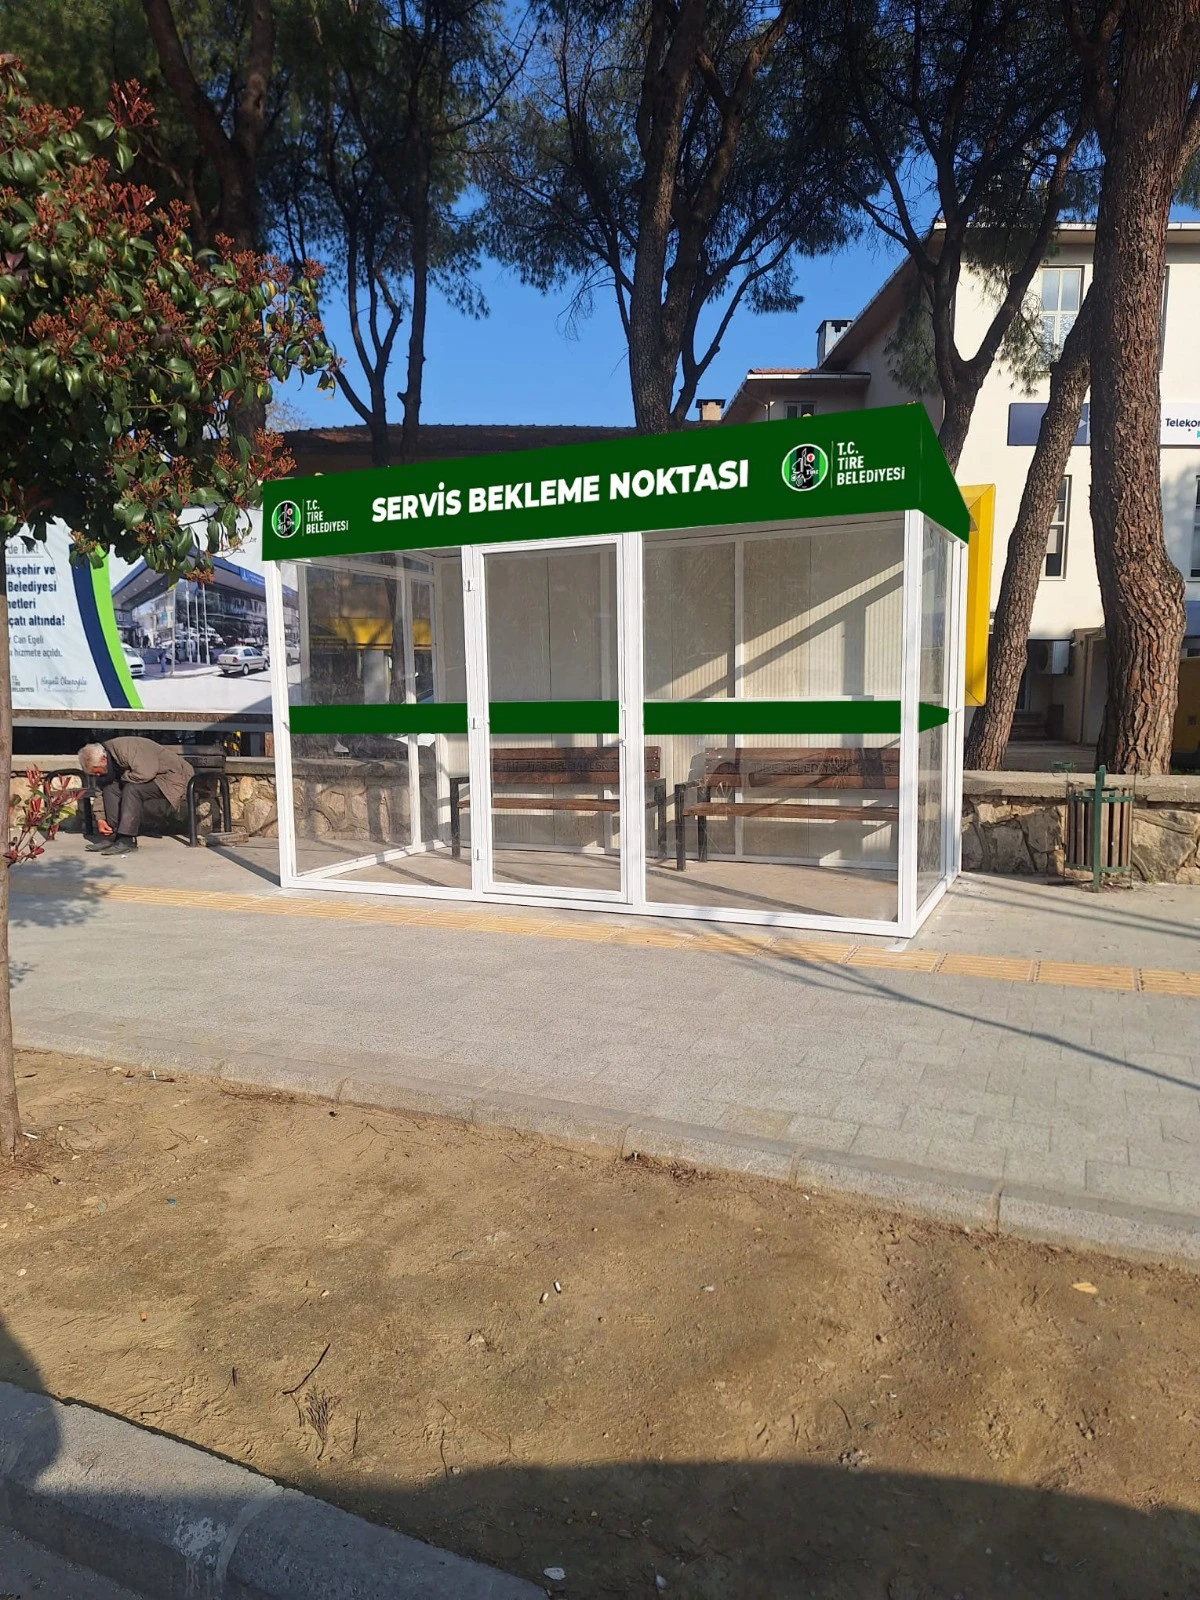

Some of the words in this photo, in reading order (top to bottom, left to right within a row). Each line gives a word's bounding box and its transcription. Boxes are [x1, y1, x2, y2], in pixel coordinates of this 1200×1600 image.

[837, 441, 859, 456] T.C.
[371, 481, 462, 523] SERVİS
[468, 475, 600, 513] BEKLEME
[609, 459, 749, 500] NOKTASI
[306, 499, 320, 511] T.C.
[44, 566, 56, 575] ve
[8, 581, 57, 594] Belediyesi
